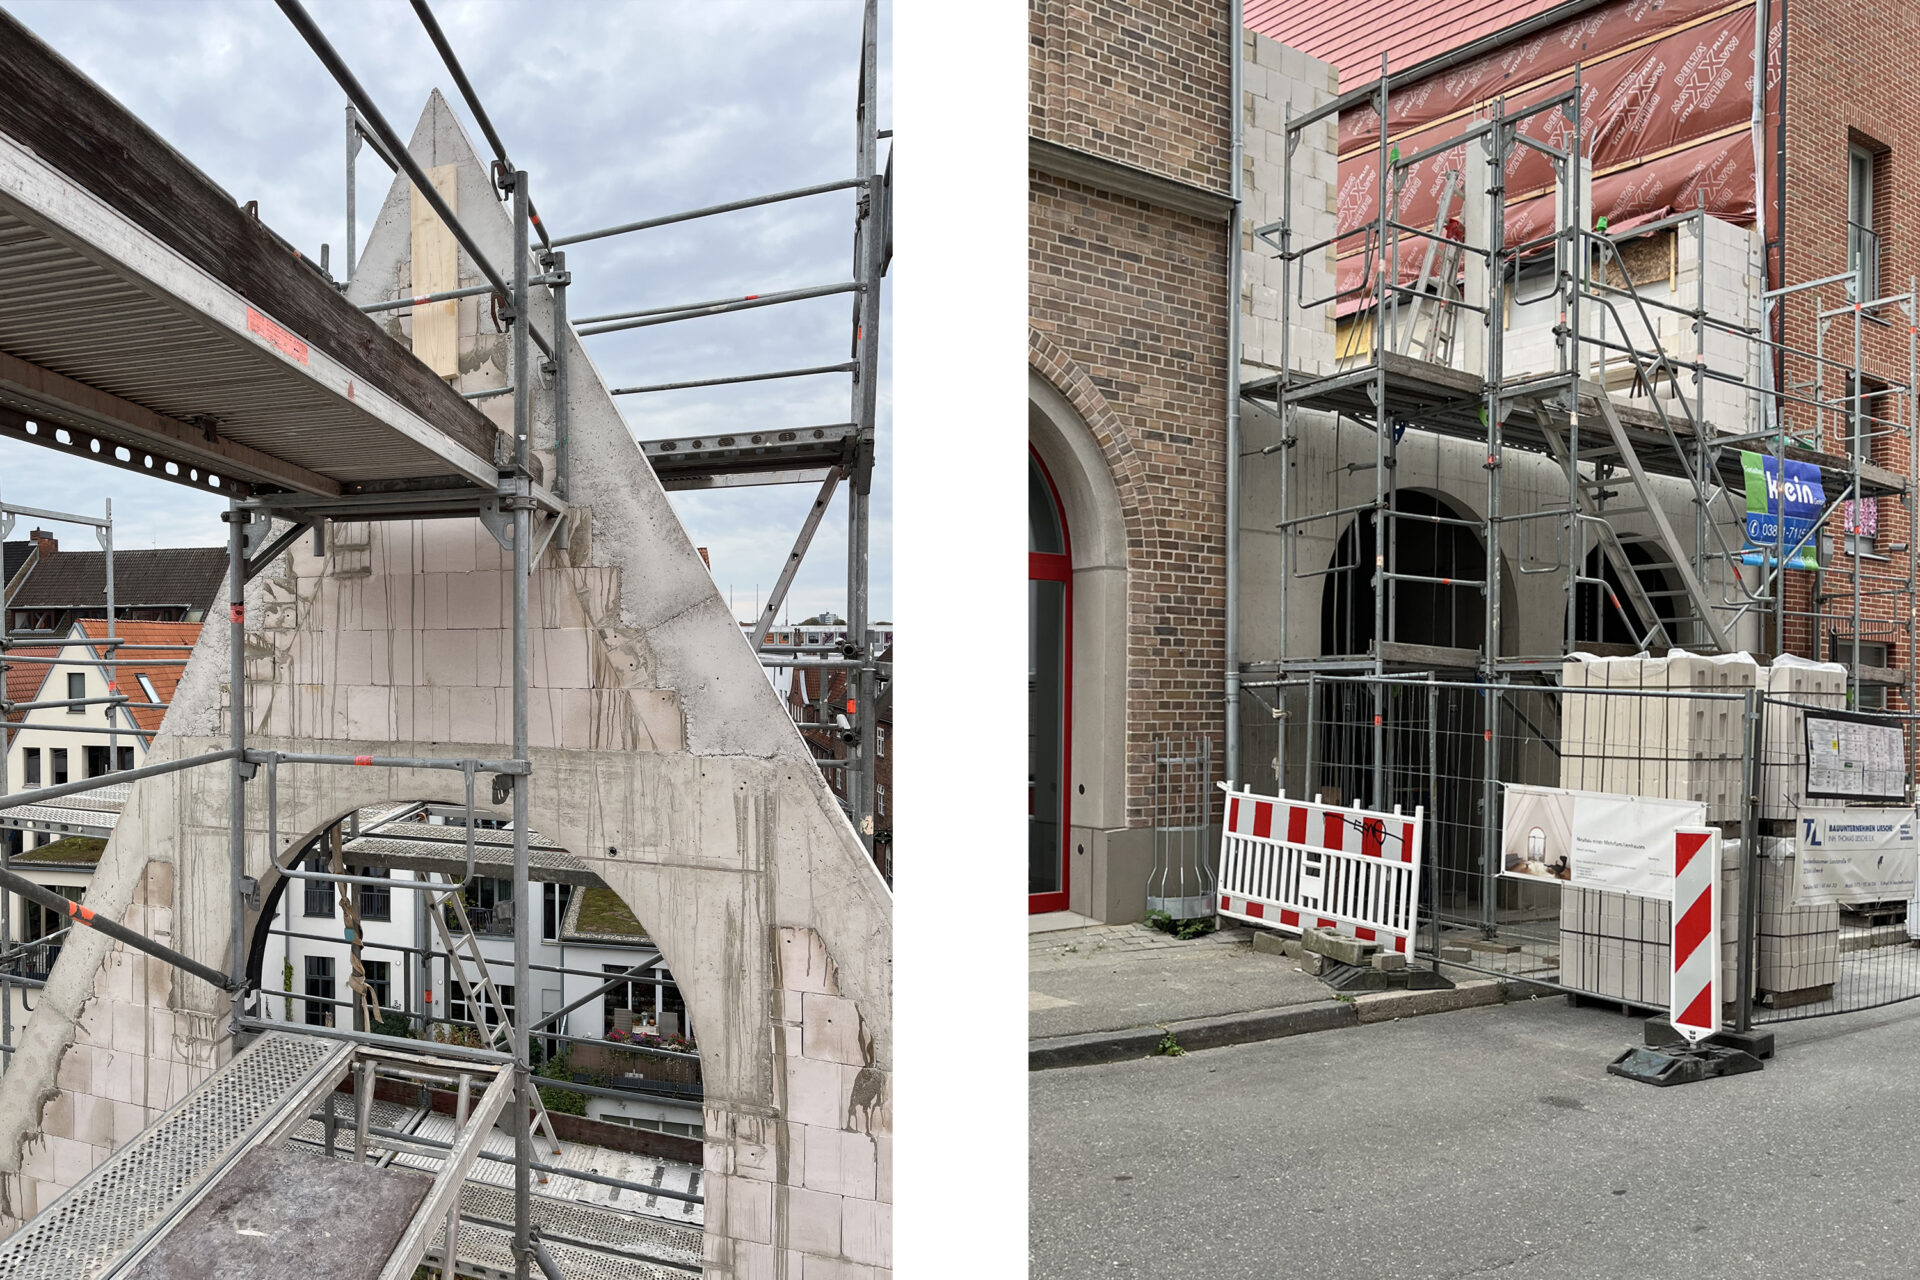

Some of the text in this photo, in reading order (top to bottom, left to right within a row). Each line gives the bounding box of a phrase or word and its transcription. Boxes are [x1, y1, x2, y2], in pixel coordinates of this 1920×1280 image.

[1712, 30, 1728, 51] PLUS
[1641, 56, 1656, 76] PLUS
[1674, 44, 1707, 87] DELTA
[1699, 68, 1733, 109] DELTA
[1766, 471, 1814, 504] kein
